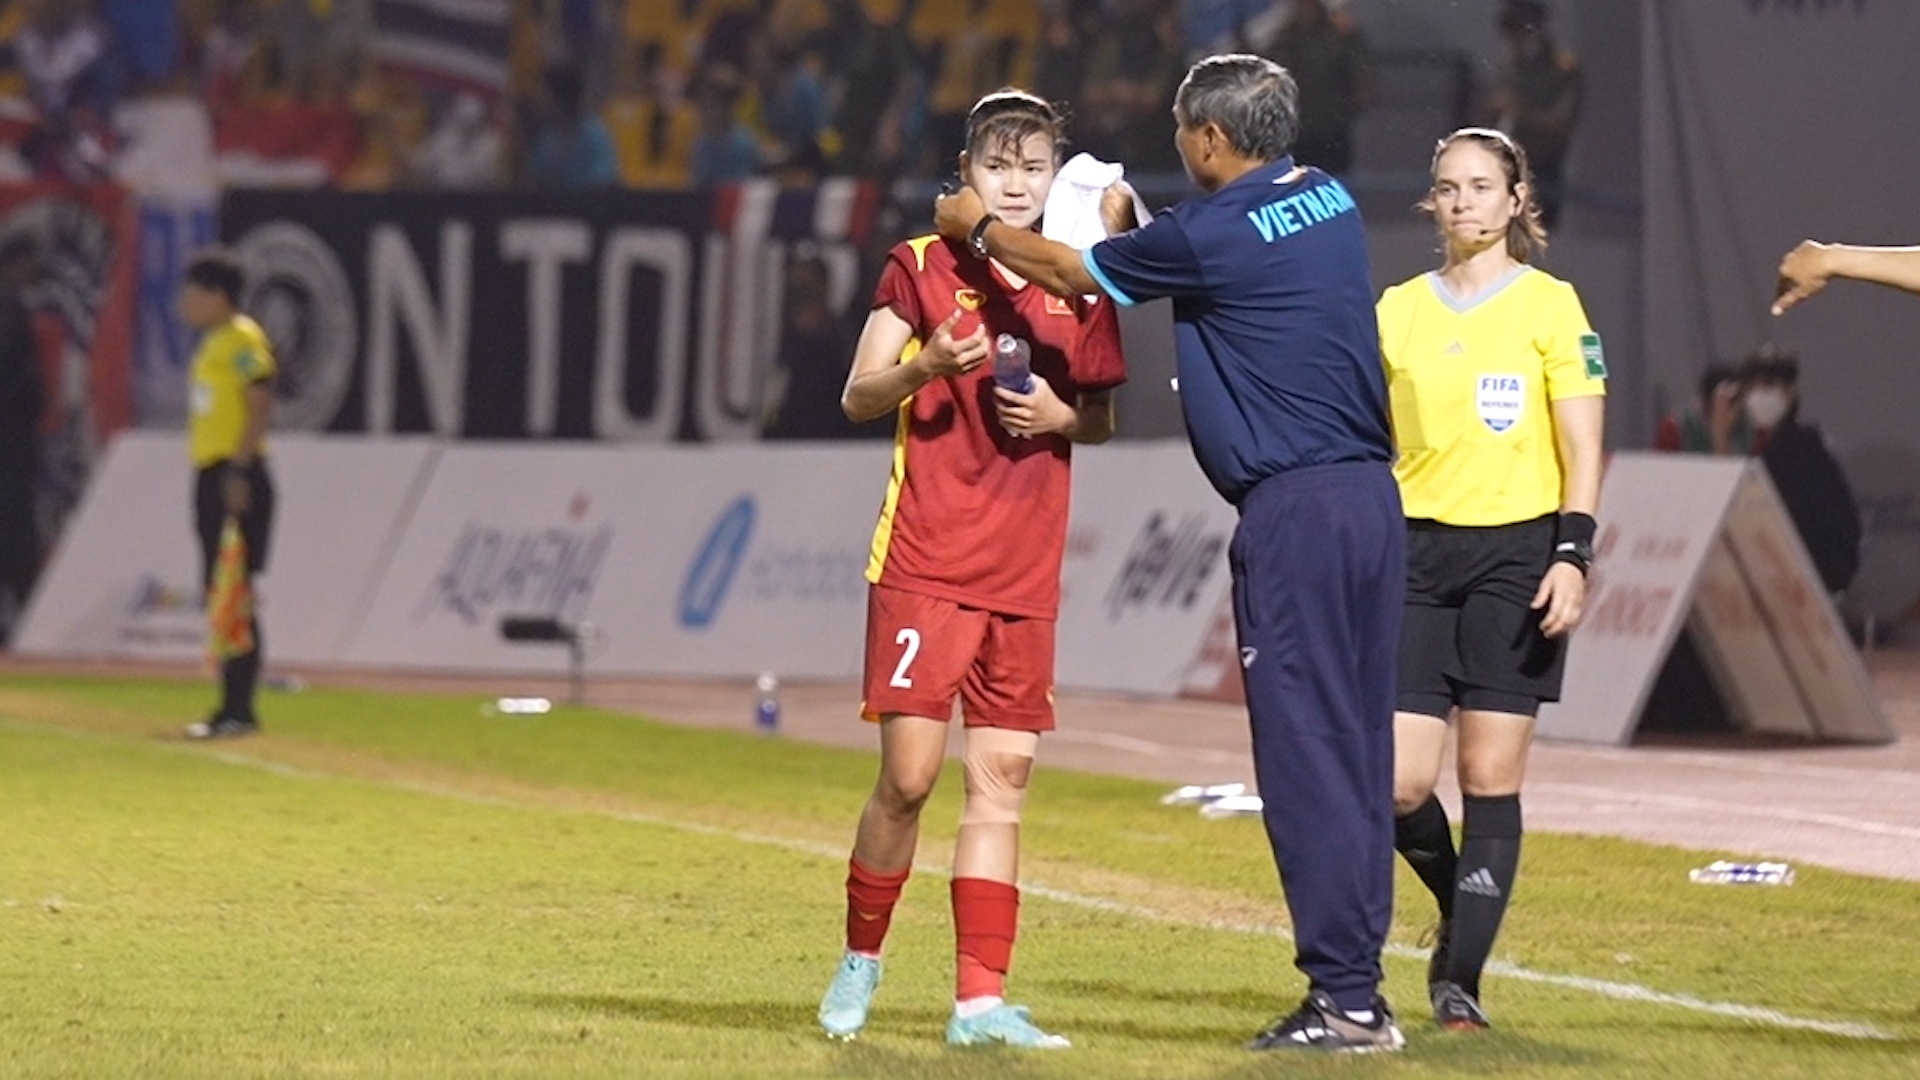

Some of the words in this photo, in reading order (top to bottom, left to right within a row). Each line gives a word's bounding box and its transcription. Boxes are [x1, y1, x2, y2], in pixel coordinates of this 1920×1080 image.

[1247, 180, 1356, 243] VIETNAM
[1482, 377, 1520, 392] FIFA
[889, 627, 921, 688] 2
